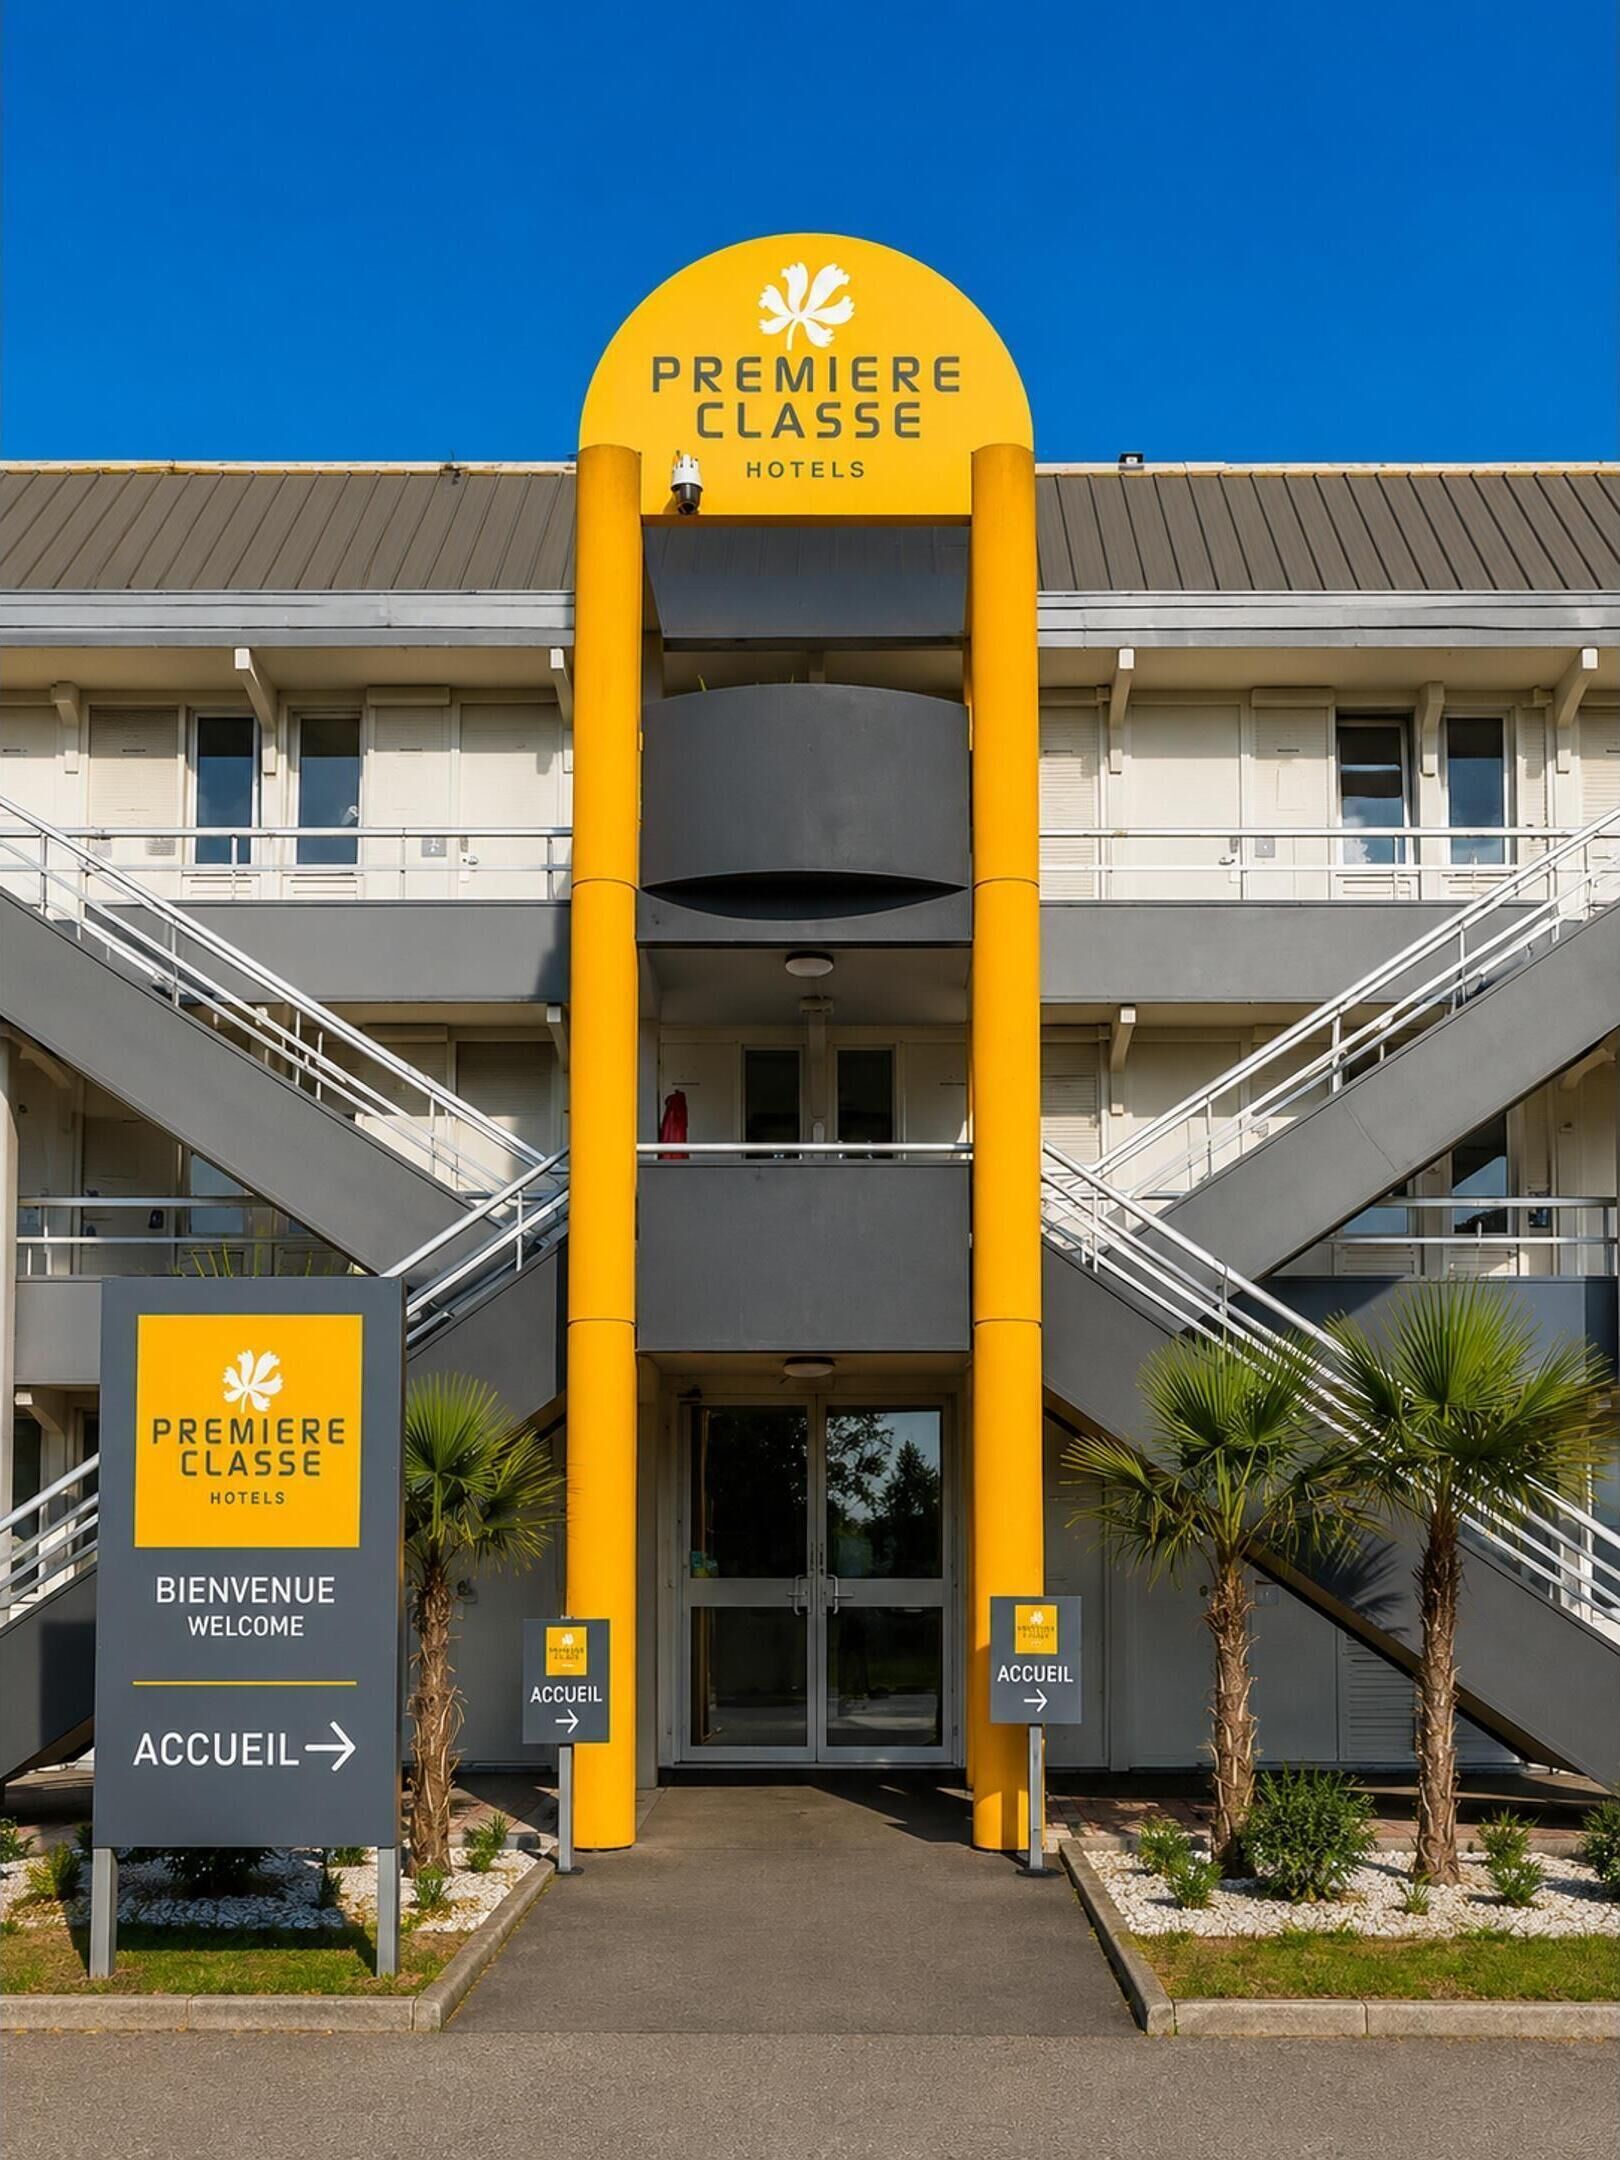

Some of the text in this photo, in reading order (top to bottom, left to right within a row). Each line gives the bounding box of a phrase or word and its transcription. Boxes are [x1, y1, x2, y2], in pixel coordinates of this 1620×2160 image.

[652, 355, 961, 393] PREMIERE
[696, 401, 921, 439] CLASSE
[746, 460, 865, 479] HOTELS
[152, 1417, 345, 1445] PREMIERE
[181, 1449, 321, 1477] CLASSE
[210, 1491, 285, 1505] HOTELS
[156, 1576, 335, 1604] BIENVENUE
[187, 1615, 305, 1637] WELCOME
[997, 1664, 1074, 1682] ACCUEIL
[530, 1685, 603, 1703] ACCUEIL
[132, 1732, 300, 1766] ACCUEIL
